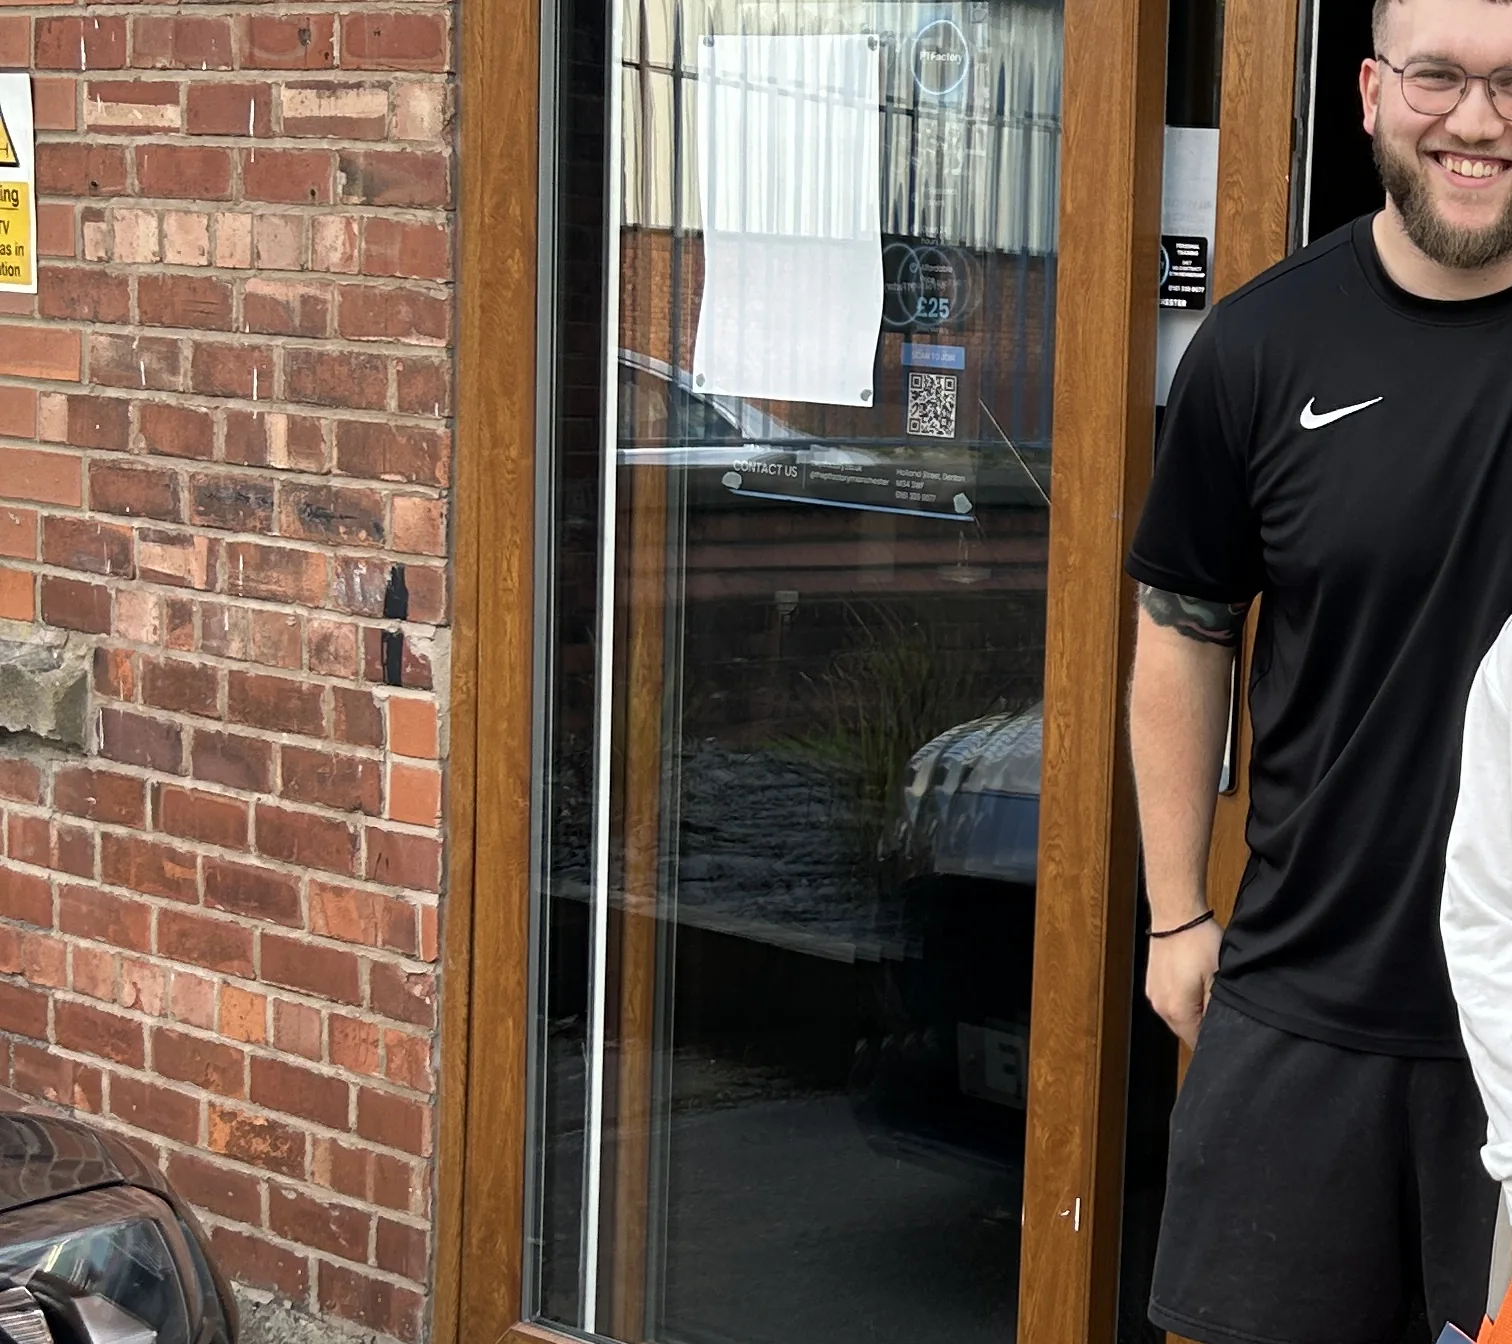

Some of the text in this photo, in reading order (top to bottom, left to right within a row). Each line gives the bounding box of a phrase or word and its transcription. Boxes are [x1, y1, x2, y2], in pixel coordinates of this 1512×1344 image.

[917, 297, 950, 319] £25
[733, 460, 798, 478] CONTACT US
